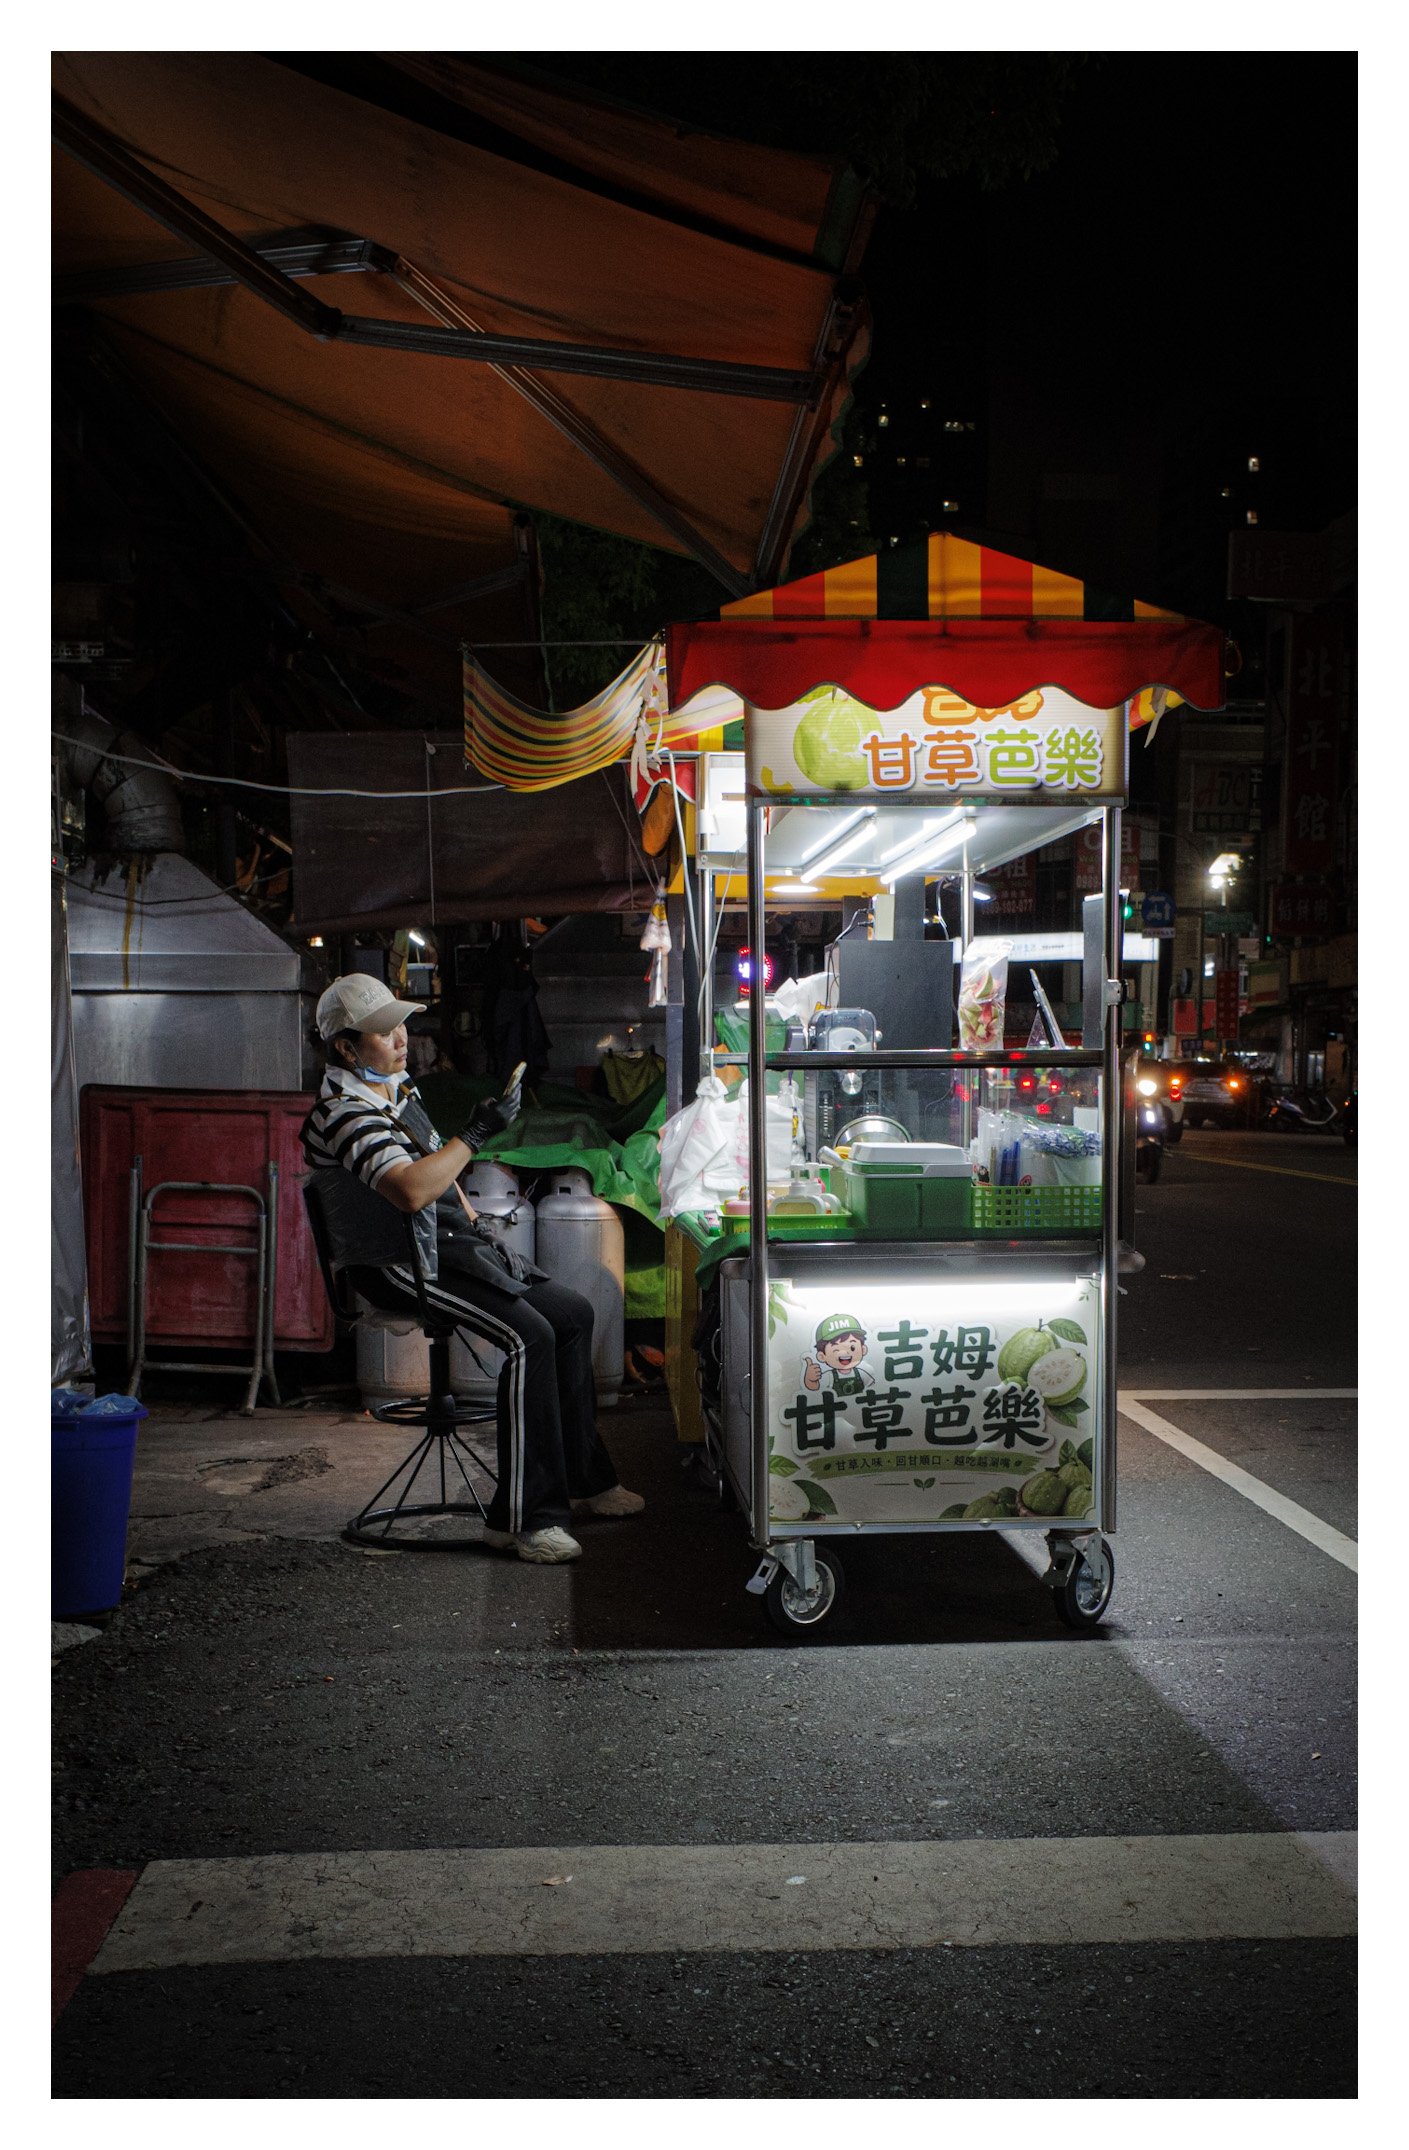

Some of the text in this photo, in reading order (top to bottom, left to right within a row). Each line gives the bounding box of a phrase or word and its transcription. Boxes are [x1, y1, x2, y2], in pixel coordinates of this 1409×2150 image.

[863, 727, 1102, 790] 甘草芭樂
[1294, 646, 1333, 841] 北平館
[828, 1318, 851, 1332] JIM
[877, 1320, 996, 1381] 吉姆
[784, 1385, 1049, 1451] 甘草芭樂
